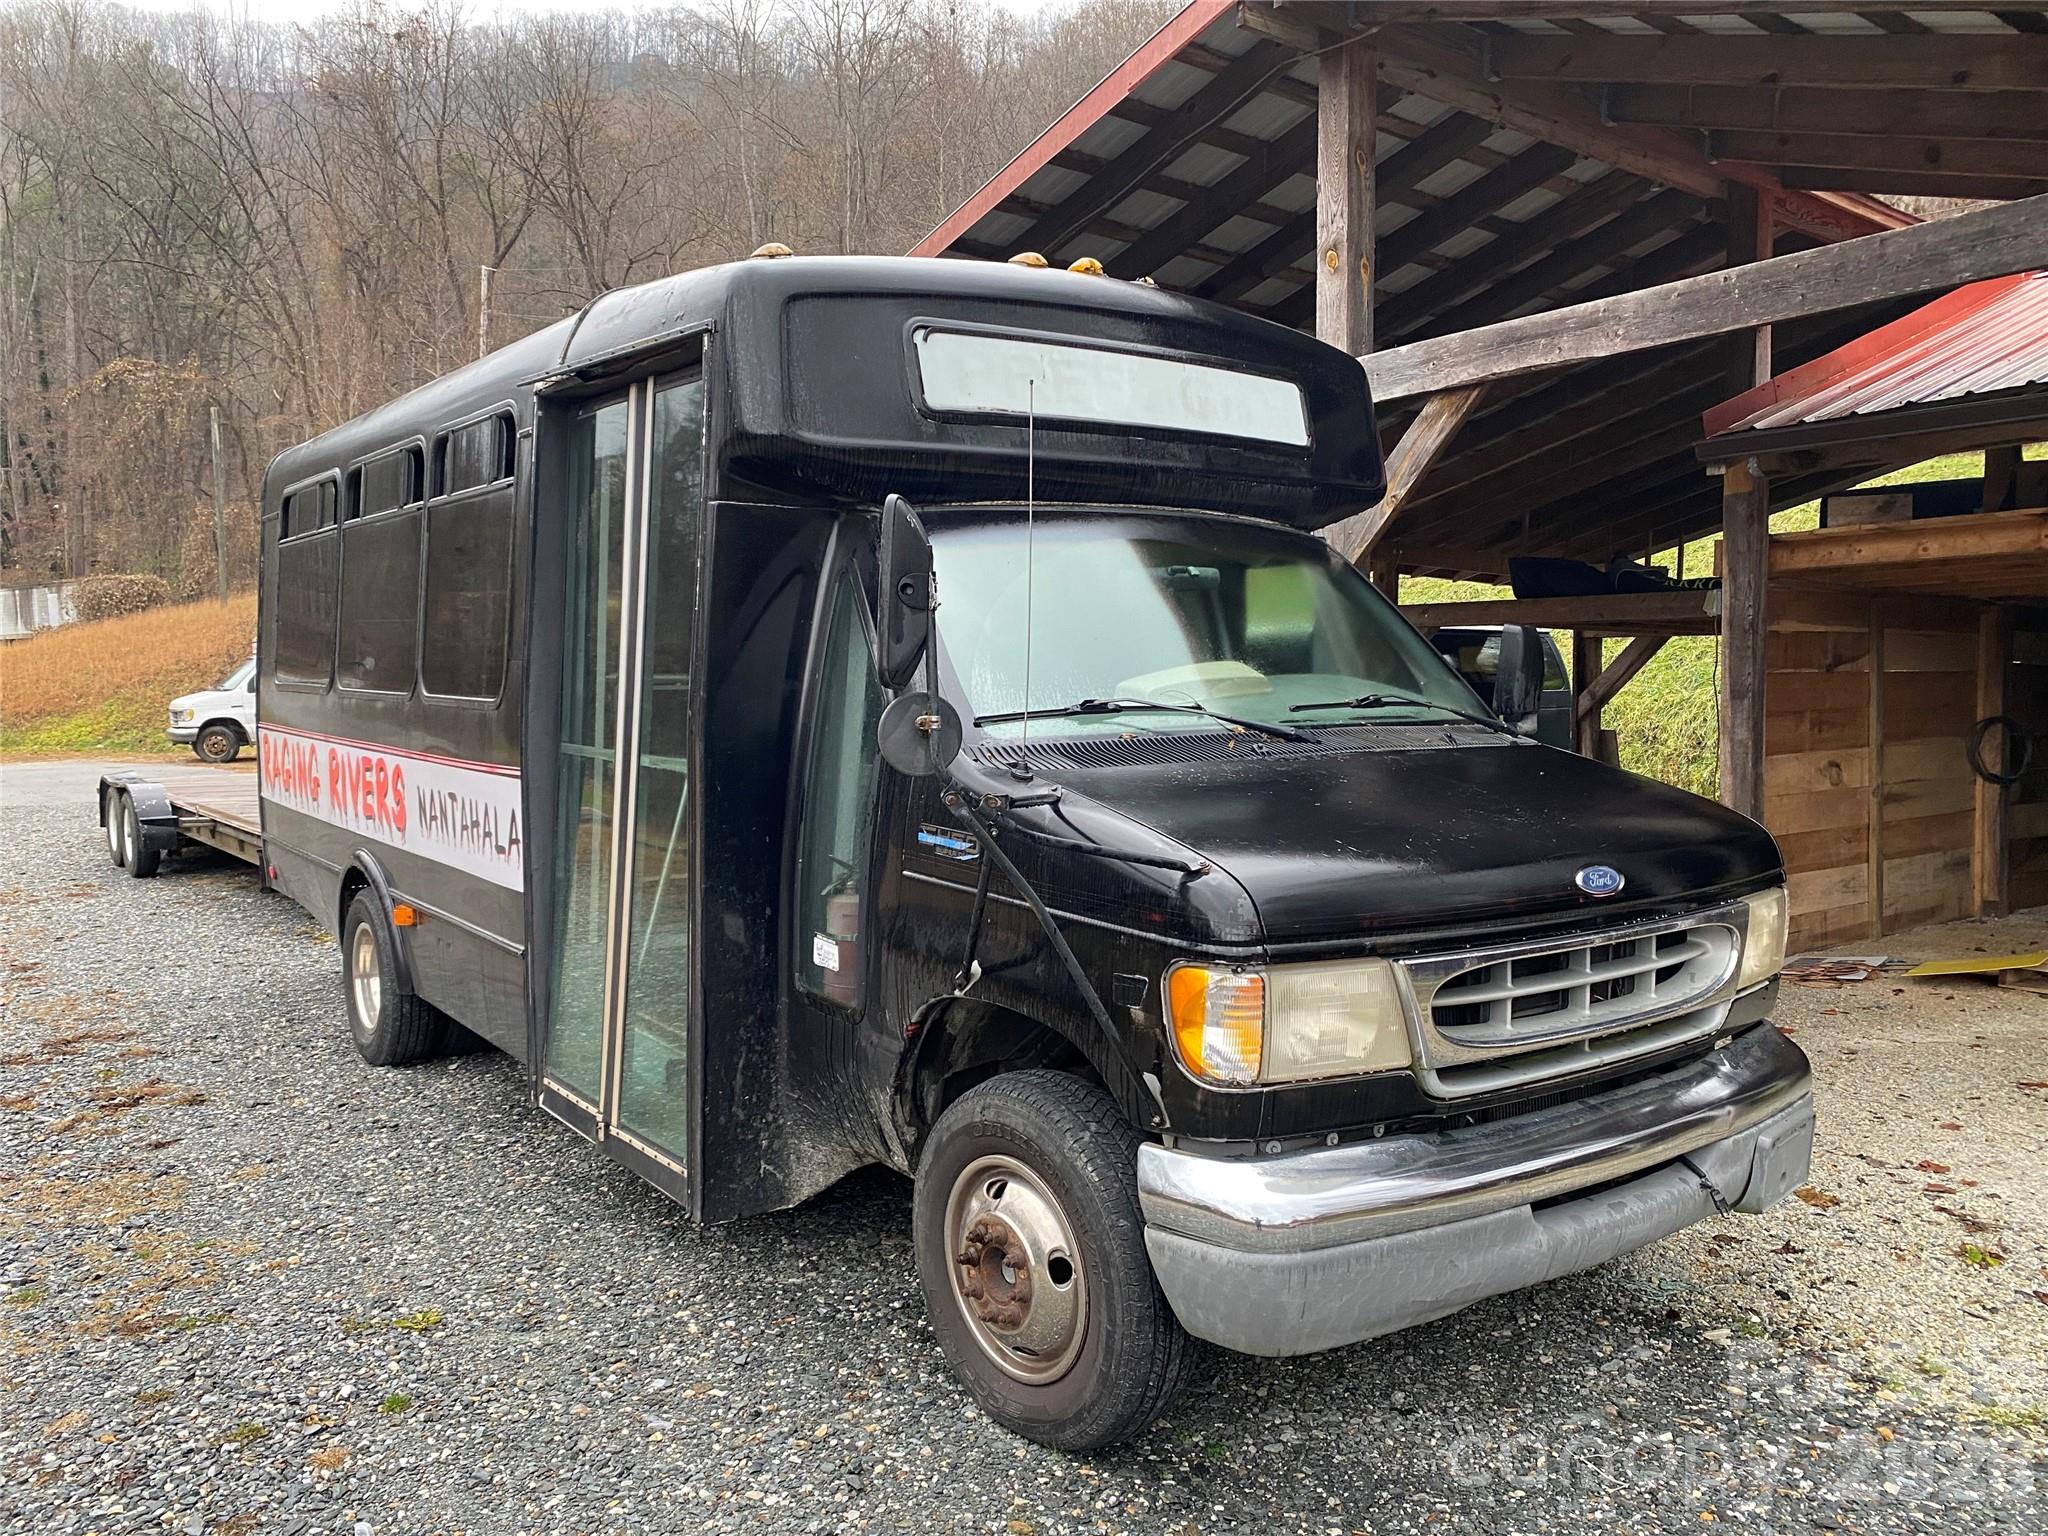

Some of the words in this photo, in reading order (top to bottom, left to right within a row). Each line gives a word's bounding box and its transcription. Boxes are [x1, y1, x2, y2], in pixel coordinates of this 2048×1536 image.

[261, 733, 321, 805] RAGING
[328, 747, 407, 838] RIVERS
[416, 785, 521, 861] NANTAHALA
[1589, 871, 1613, 887] Ford
